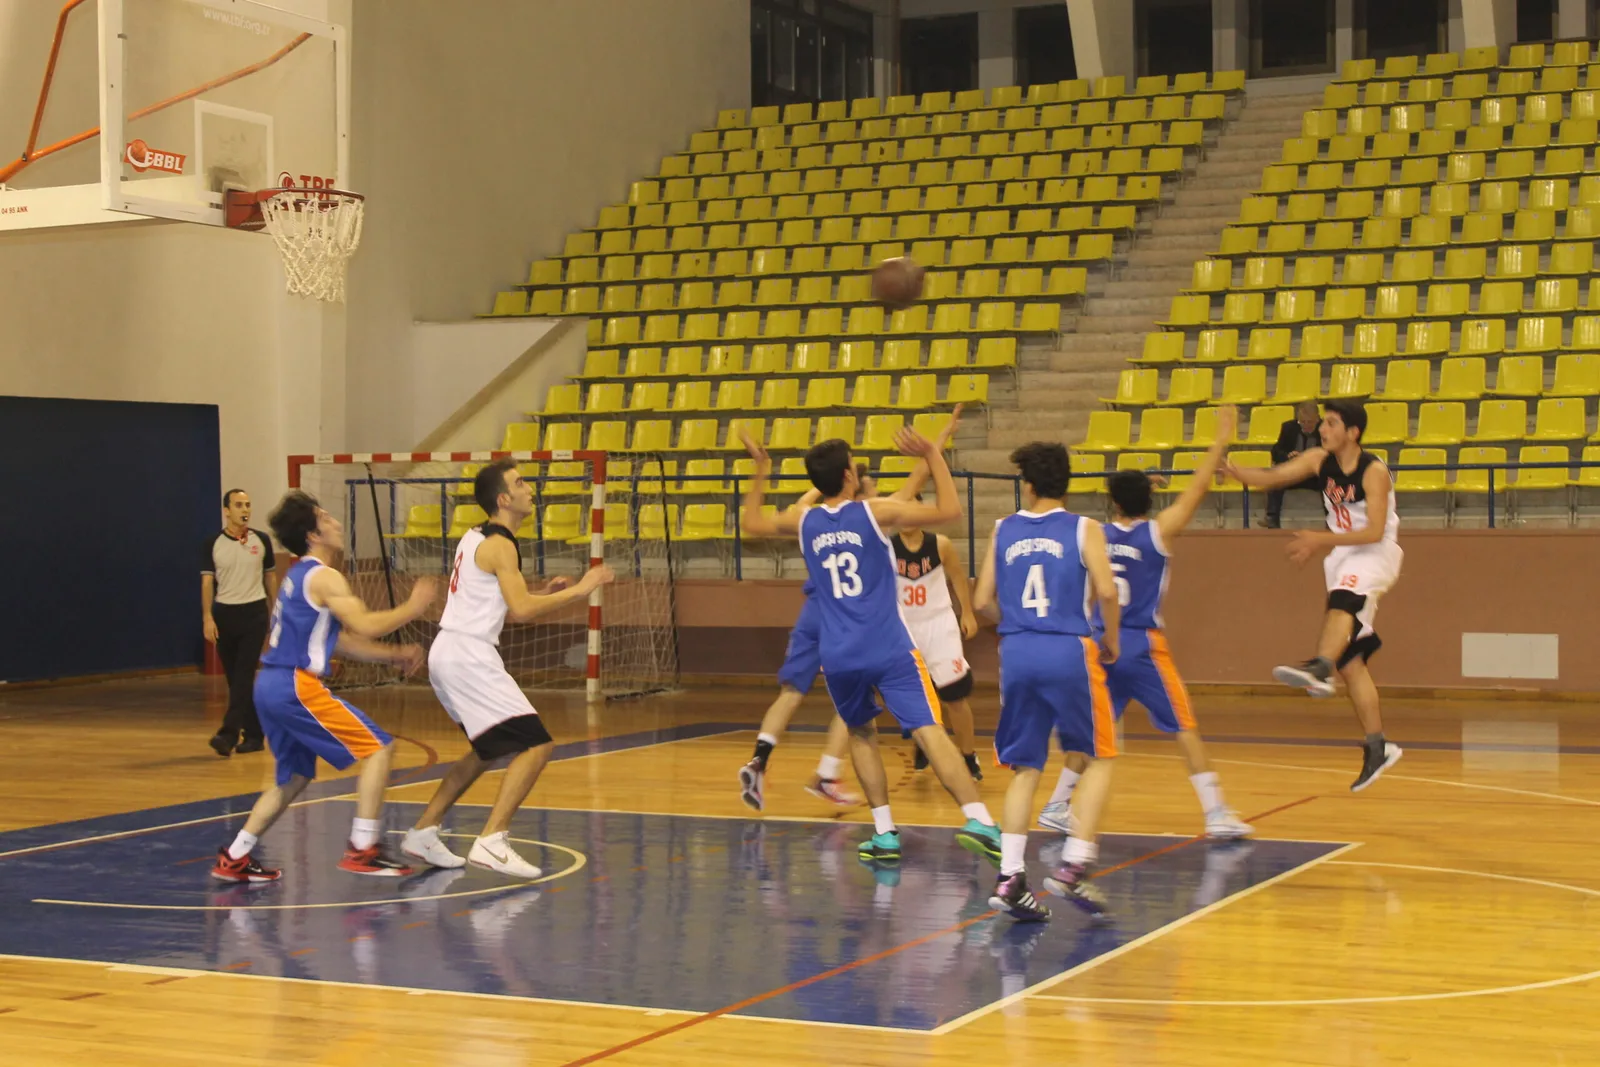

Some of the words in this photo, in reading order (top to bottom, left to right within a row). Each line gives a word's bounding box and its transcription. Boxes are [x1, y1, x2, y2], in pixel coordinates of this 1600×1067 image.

[144, 151, 182, 171] EBBL
[300, 175, 335, 201] TBF
[1332, 504, 1353, 533] 19
[822, 551, 863, 599] 13
[903, 584, 927, 607] 38
[1021, 564, 1050, 618] 4
